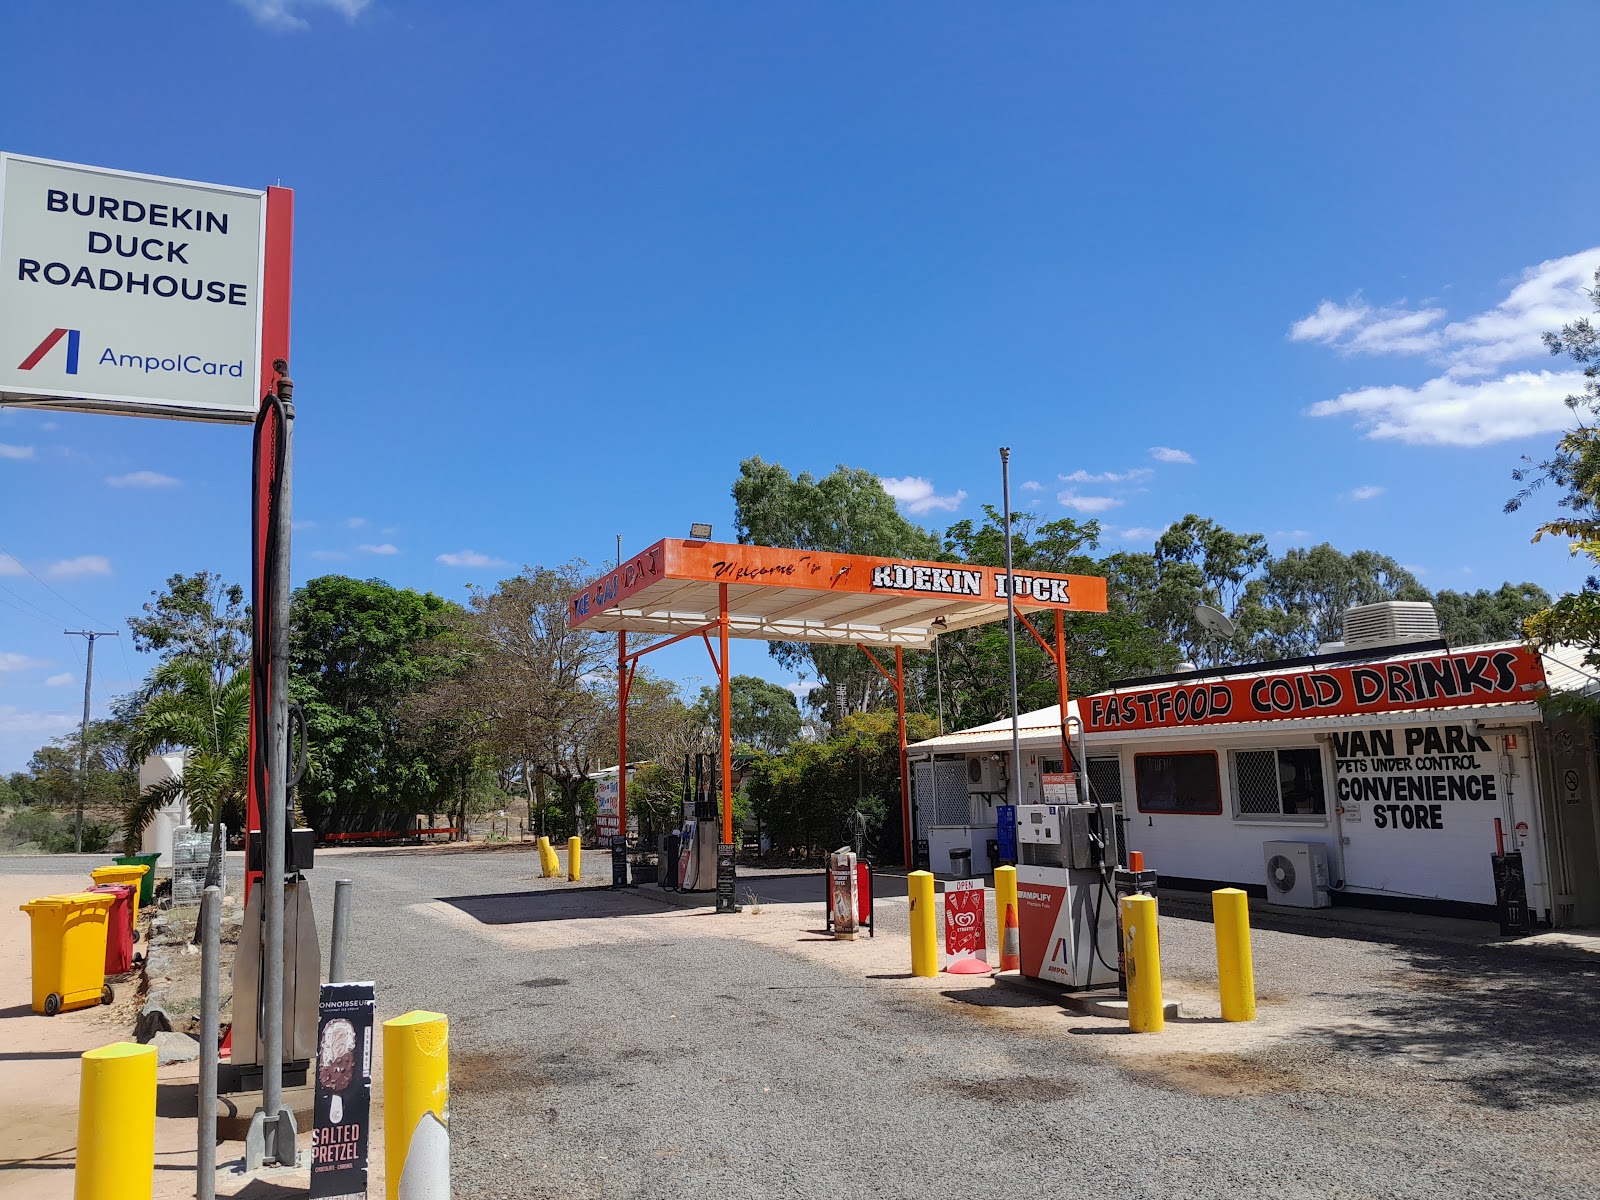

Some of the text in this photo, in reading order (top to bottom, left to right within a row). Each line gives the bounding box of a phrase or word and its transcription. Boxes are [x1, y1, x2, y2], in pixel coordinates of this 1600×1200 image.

[47, 189, 228, 234] BURDEKIN
[88, 231, 189, 264] DUCK
[18, 258, 247, 306] ROADHOUSE
[99, 348, 243, 377] AmpolCard
[1091, 652, 1518, 727] FASTFOOD COLD DRINKS
[1333, 724, 1492, 757] VAN PARK
[1336, 755, 1481, 773] PETS UNDER CONTROL
[1338, 775, 1497, 801] CONVENIENCE
[1373, 804, 1443, 829] STORE
[956, 881, 973, 890] OPEN
[1022, 891, 1051, 901] AMPLIFY
[1048, 966, 1068, 975] AMPOL
[312, 1124, 359, 1145] SALTED
[312, 1142, 359, 1164] PRETZEL
